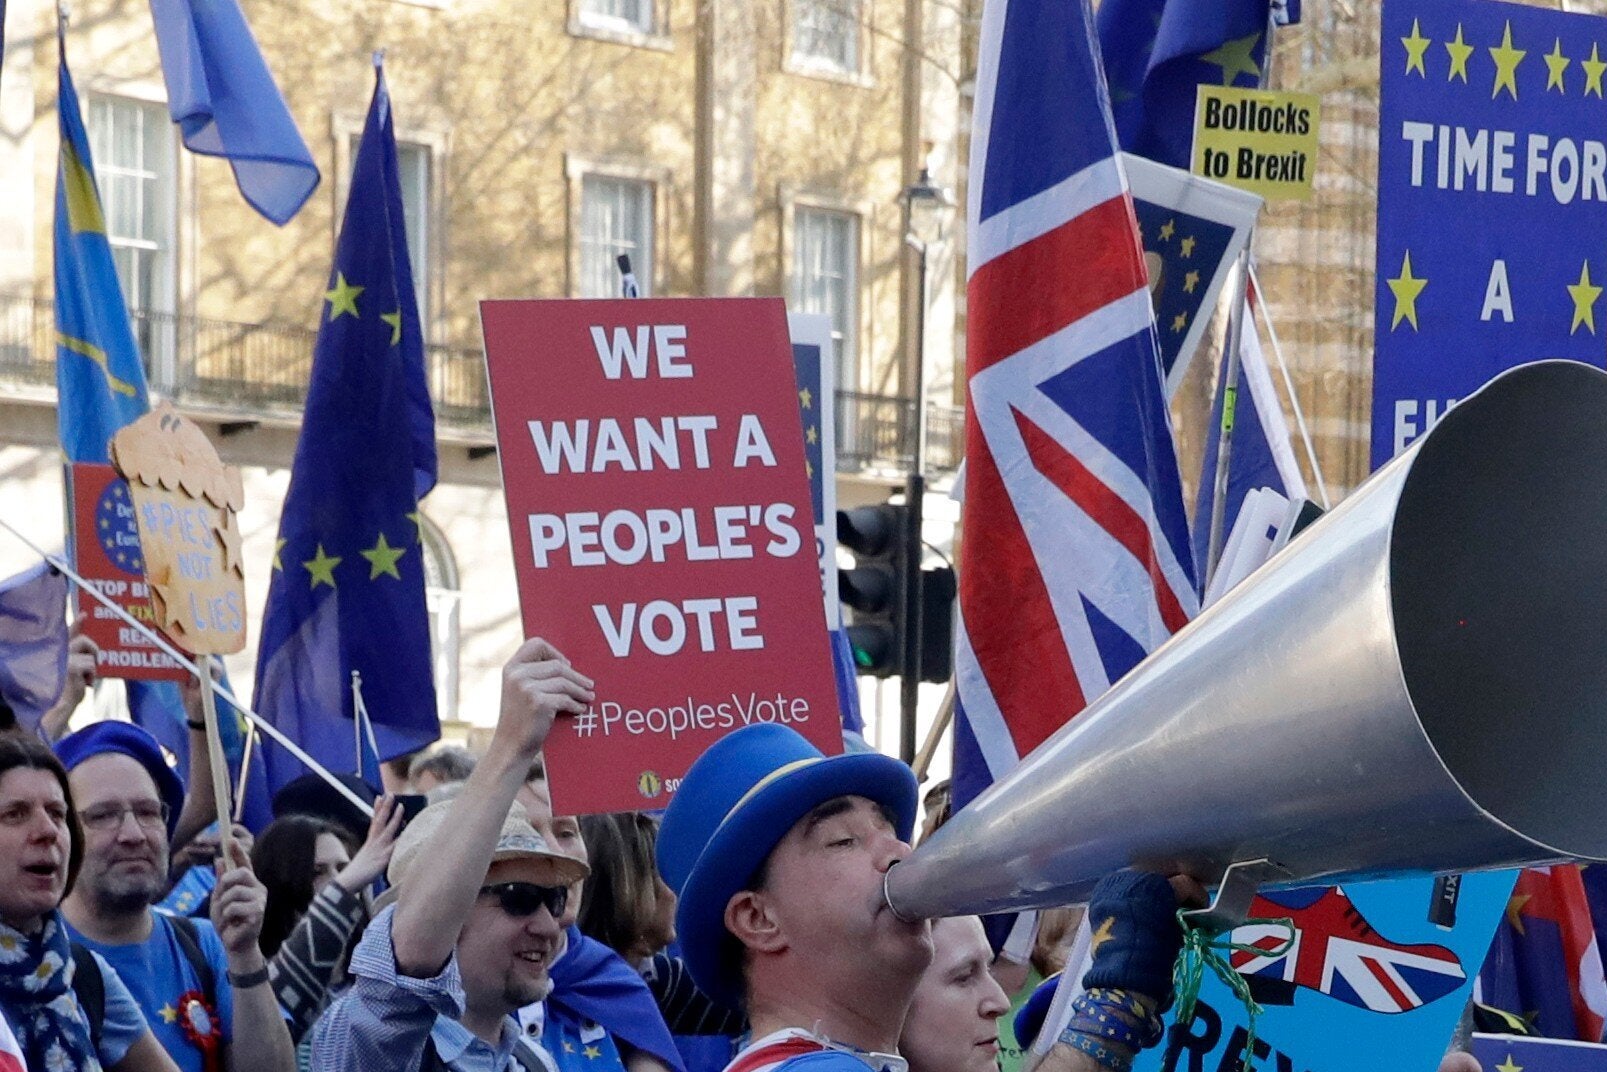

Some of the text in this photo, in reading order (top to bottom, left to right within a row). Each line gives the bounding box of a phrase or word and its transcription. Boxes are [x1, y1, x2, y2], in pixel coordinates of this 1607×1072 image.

[1205, 97, 1310, 136] Bollocks
[1203, 146, 1306, 182] to Brexit
[1402, 120, 1515, 194] TIME
[1480, 259, 1515, 323] A
[589, 324, 694, 380] WE
[526, 414, 778, 475] WANT A
[527, 502, 802, 569] PEOPLE'S
[178, 552, 213, 581] NOT
[190, 591, 242, 632] LIES
[591, 596, 765, 658] VOTE
[572, 692, 810, 740] #PeoplesVote
